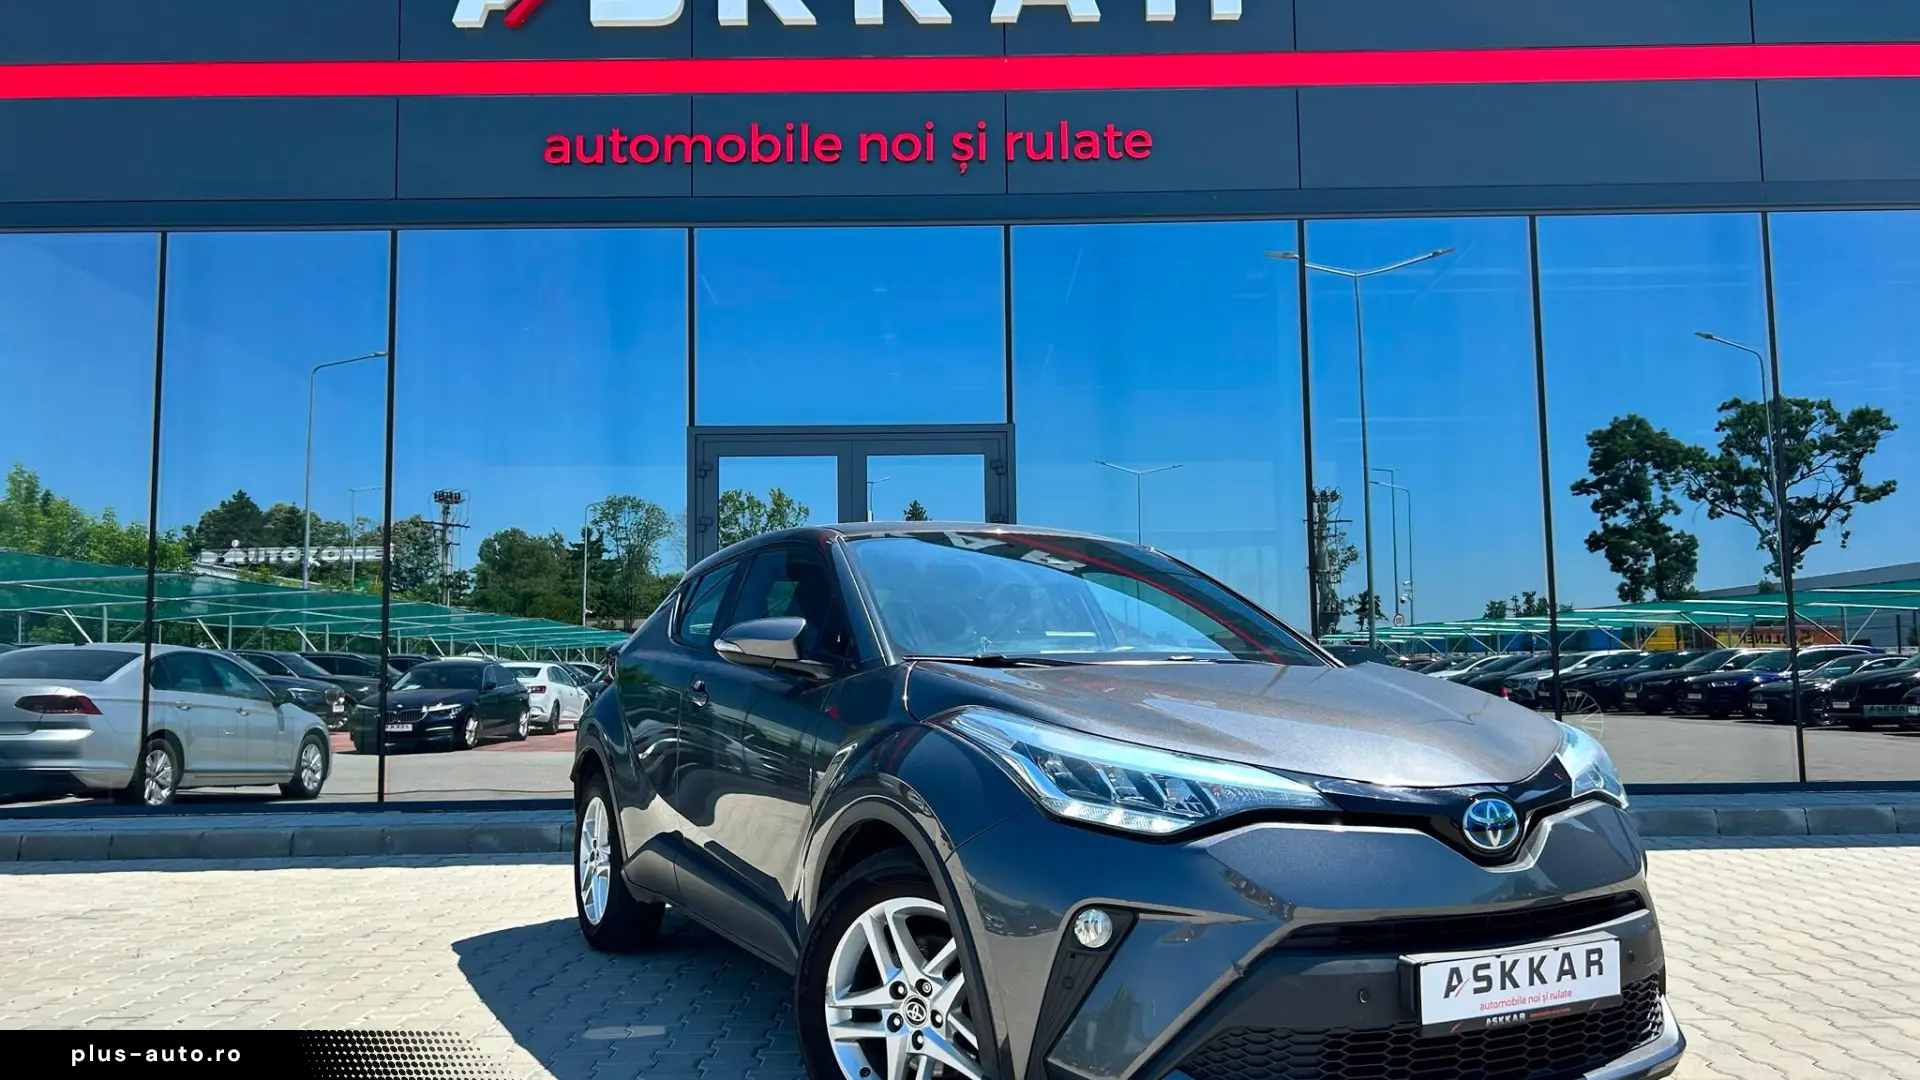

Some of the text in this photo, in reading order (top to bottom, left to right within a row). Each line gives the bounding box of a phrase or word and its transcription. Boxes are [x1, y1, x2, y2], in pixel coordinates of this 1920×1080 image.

[543, 120, 1153, 173] automobile noi și rulate
[1443, 947, 1604, 999] ASKKAR
[1480, 995, 1526, 1011] automobile
[1528, 992, 1541, 1004] noi
[1550, 989, 1573, 1000] rulate
[1485, 1012, 1526, 1028] ASKKAR
